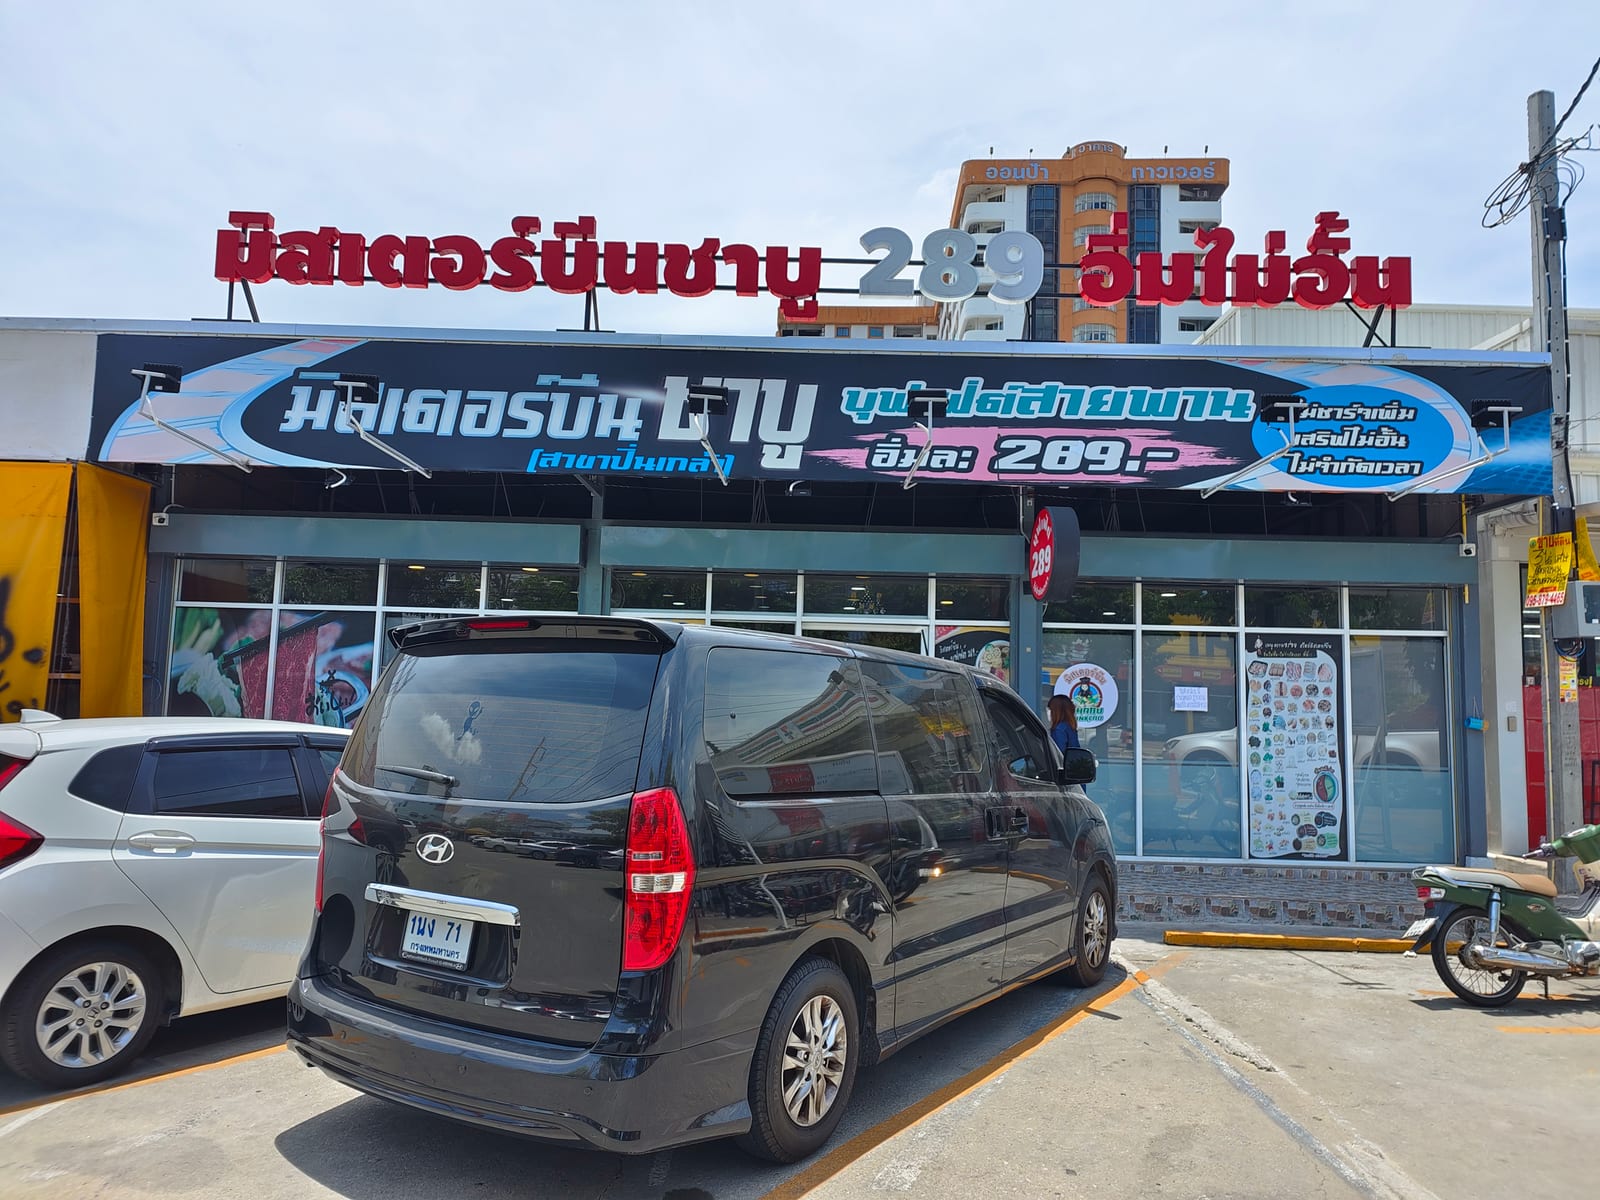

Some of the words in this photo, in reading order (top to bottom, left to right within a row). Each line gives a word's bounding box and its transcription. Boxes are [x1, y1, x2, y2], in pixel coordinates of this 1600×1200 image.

[1078, 142, 1113, 153] อาคาร
[1131, 161, 1216, 180] ทาวเวอร์
[215, 211, 822, 321] มิสเตอร์บีนชาบู
[858, 226, 1045, 305] 289
[1078, 211, 1412, 311] อิ่มไม่อั้น
[1284, 452, 1422, 475] ไม่จำกัดเวลา
[1032, 544, 1051, 578] 289
[445, 921, 462, 943] 71
[410, 942, 460, 959] กรุงเทพมหานคร
